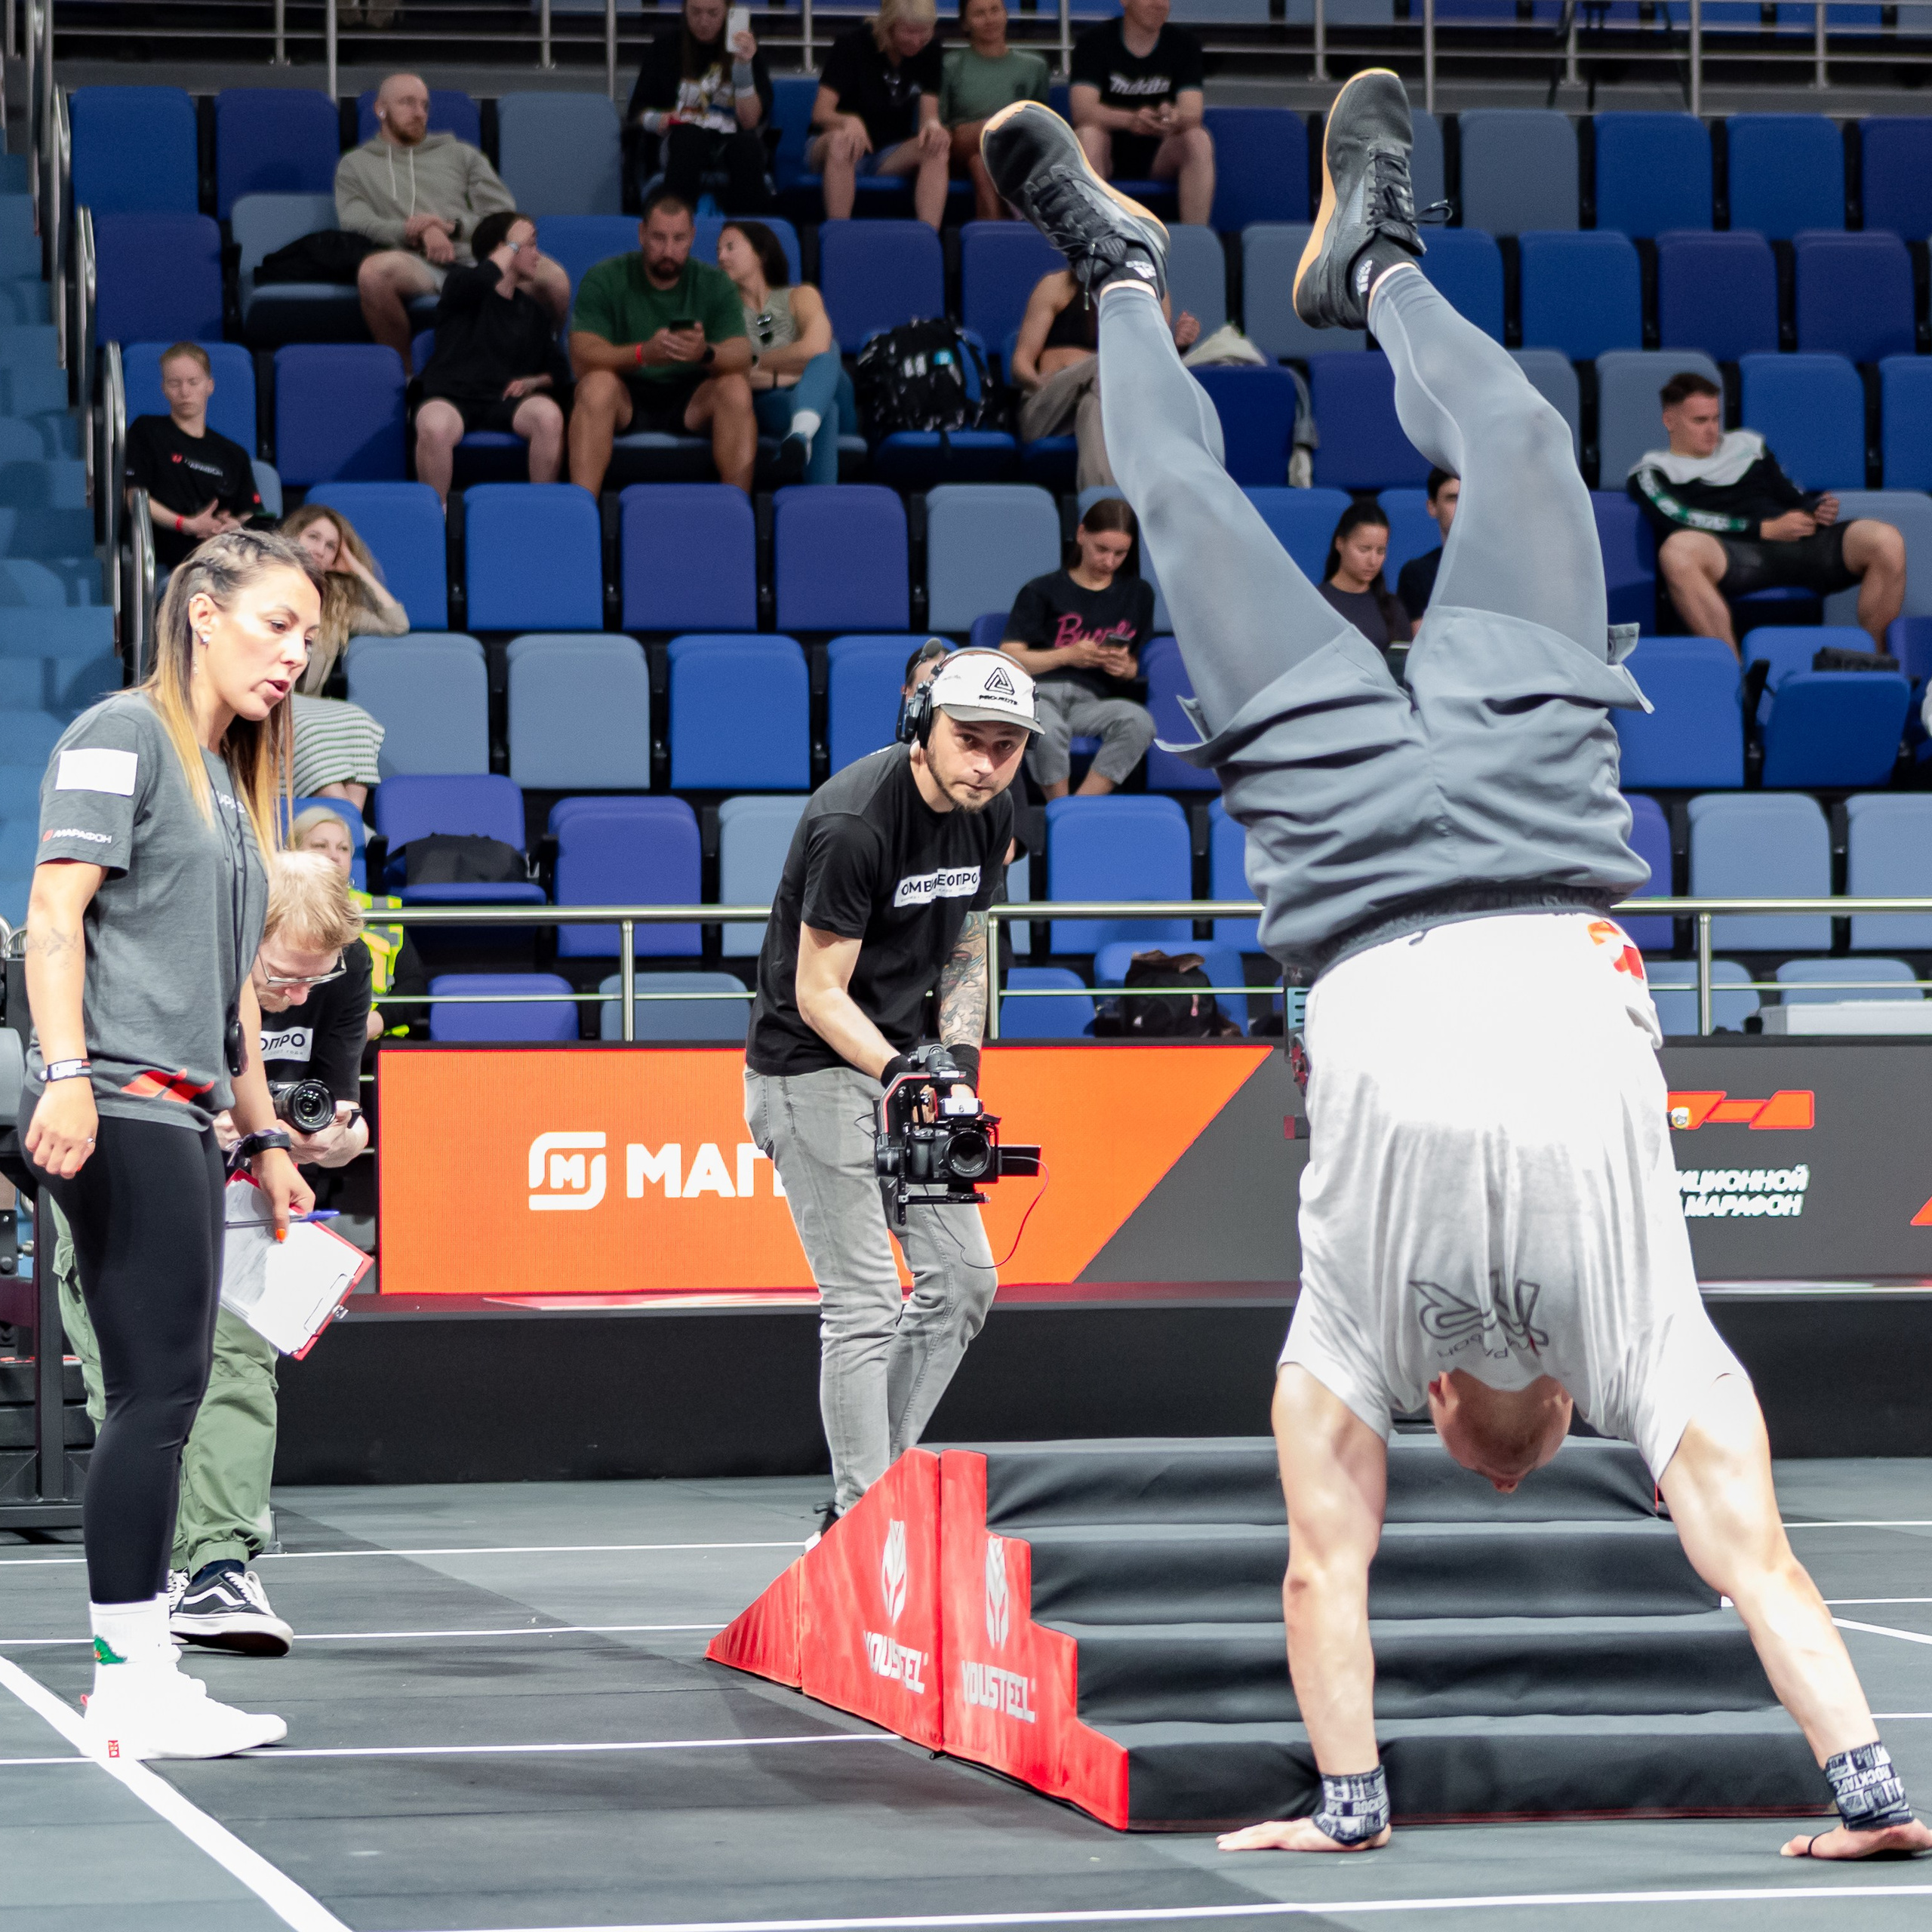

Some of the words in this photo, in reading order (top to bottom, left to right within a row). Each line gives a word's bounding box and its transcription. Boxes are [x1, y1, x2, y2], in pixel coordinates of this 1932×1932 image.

[52, 829, 112, 844] МАРАФОН
[1684, 1194, 1804, 1217] МАРАФОН
[961, 1660, 1036, 1716] YOUSTEEL
